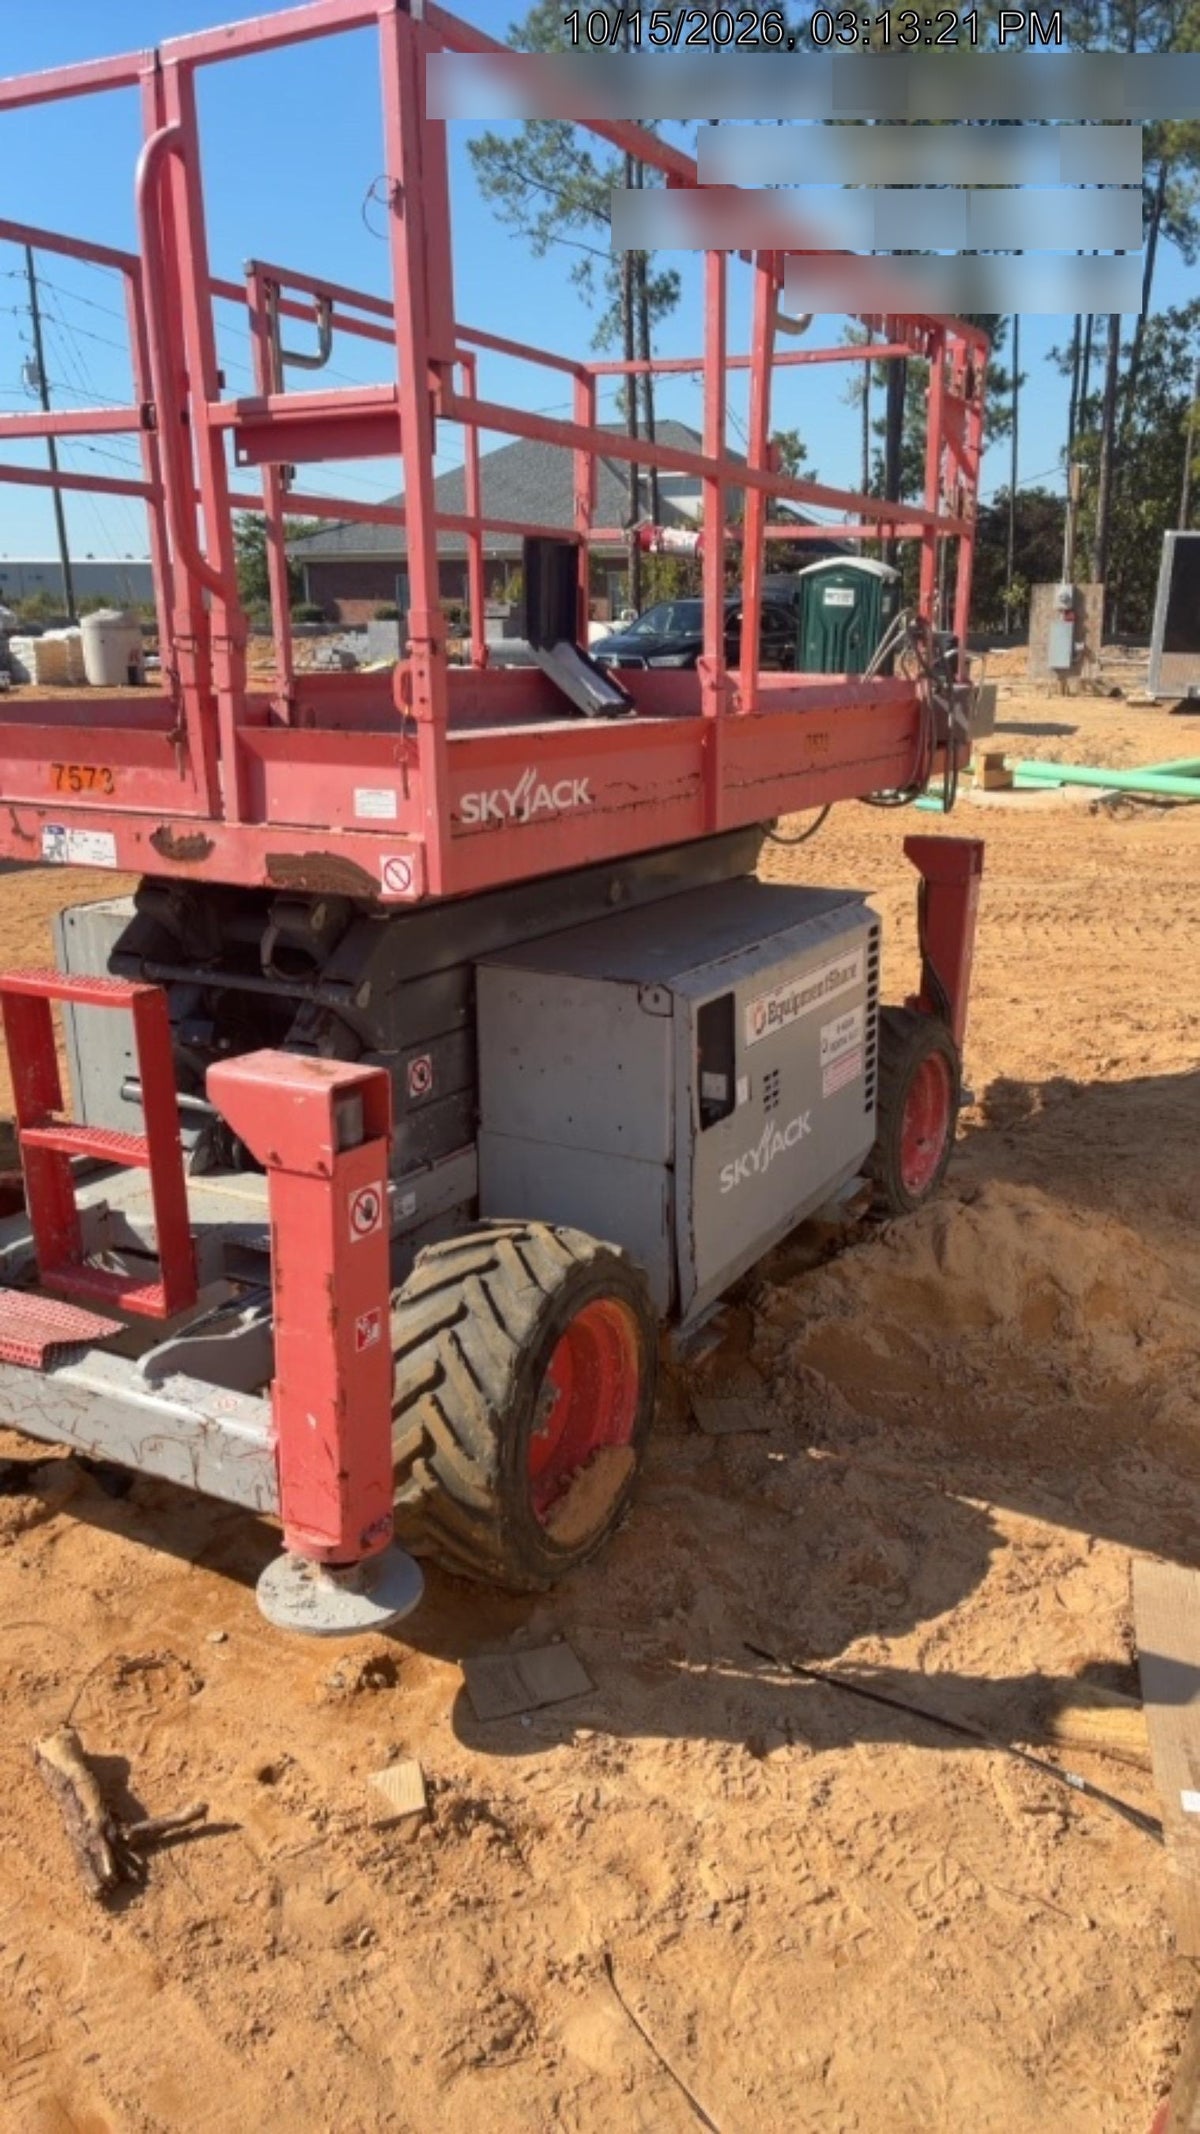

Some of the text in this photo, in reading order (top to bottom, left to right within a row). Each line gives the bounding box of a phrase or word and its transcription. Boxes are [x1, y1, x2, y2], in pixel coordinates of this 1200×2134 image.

[51, 763, 115, 795] 7573
[460, 767, 592, 824] SKYJACK
[720, 1109, 812, 1195] SKYJACK
